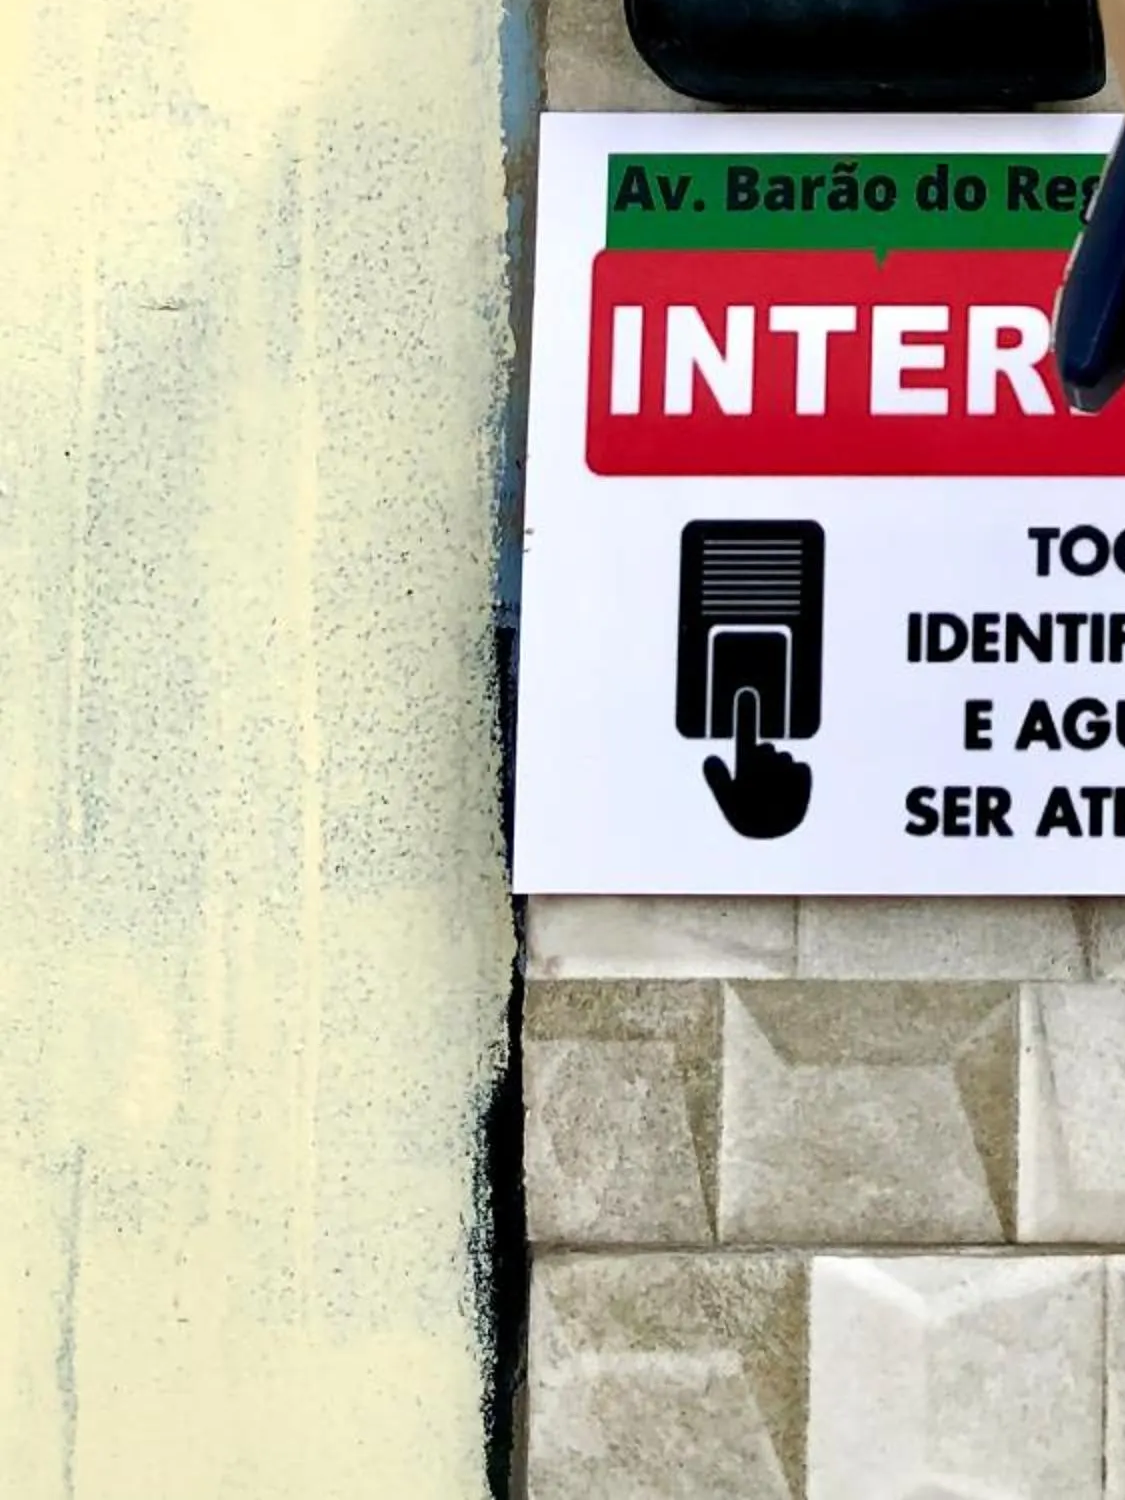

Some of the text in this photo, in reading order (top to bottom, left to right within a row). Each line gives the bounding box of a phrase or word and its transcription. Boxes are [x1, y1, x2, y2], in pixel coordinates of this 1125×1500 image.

[613, 164, 706, 213] Av.
[726, 161, 898, 213] Barão
[915, 163, 987, 212] do
[964, 699, 994, 751] E
[905, 785, 1014, 837] SER
